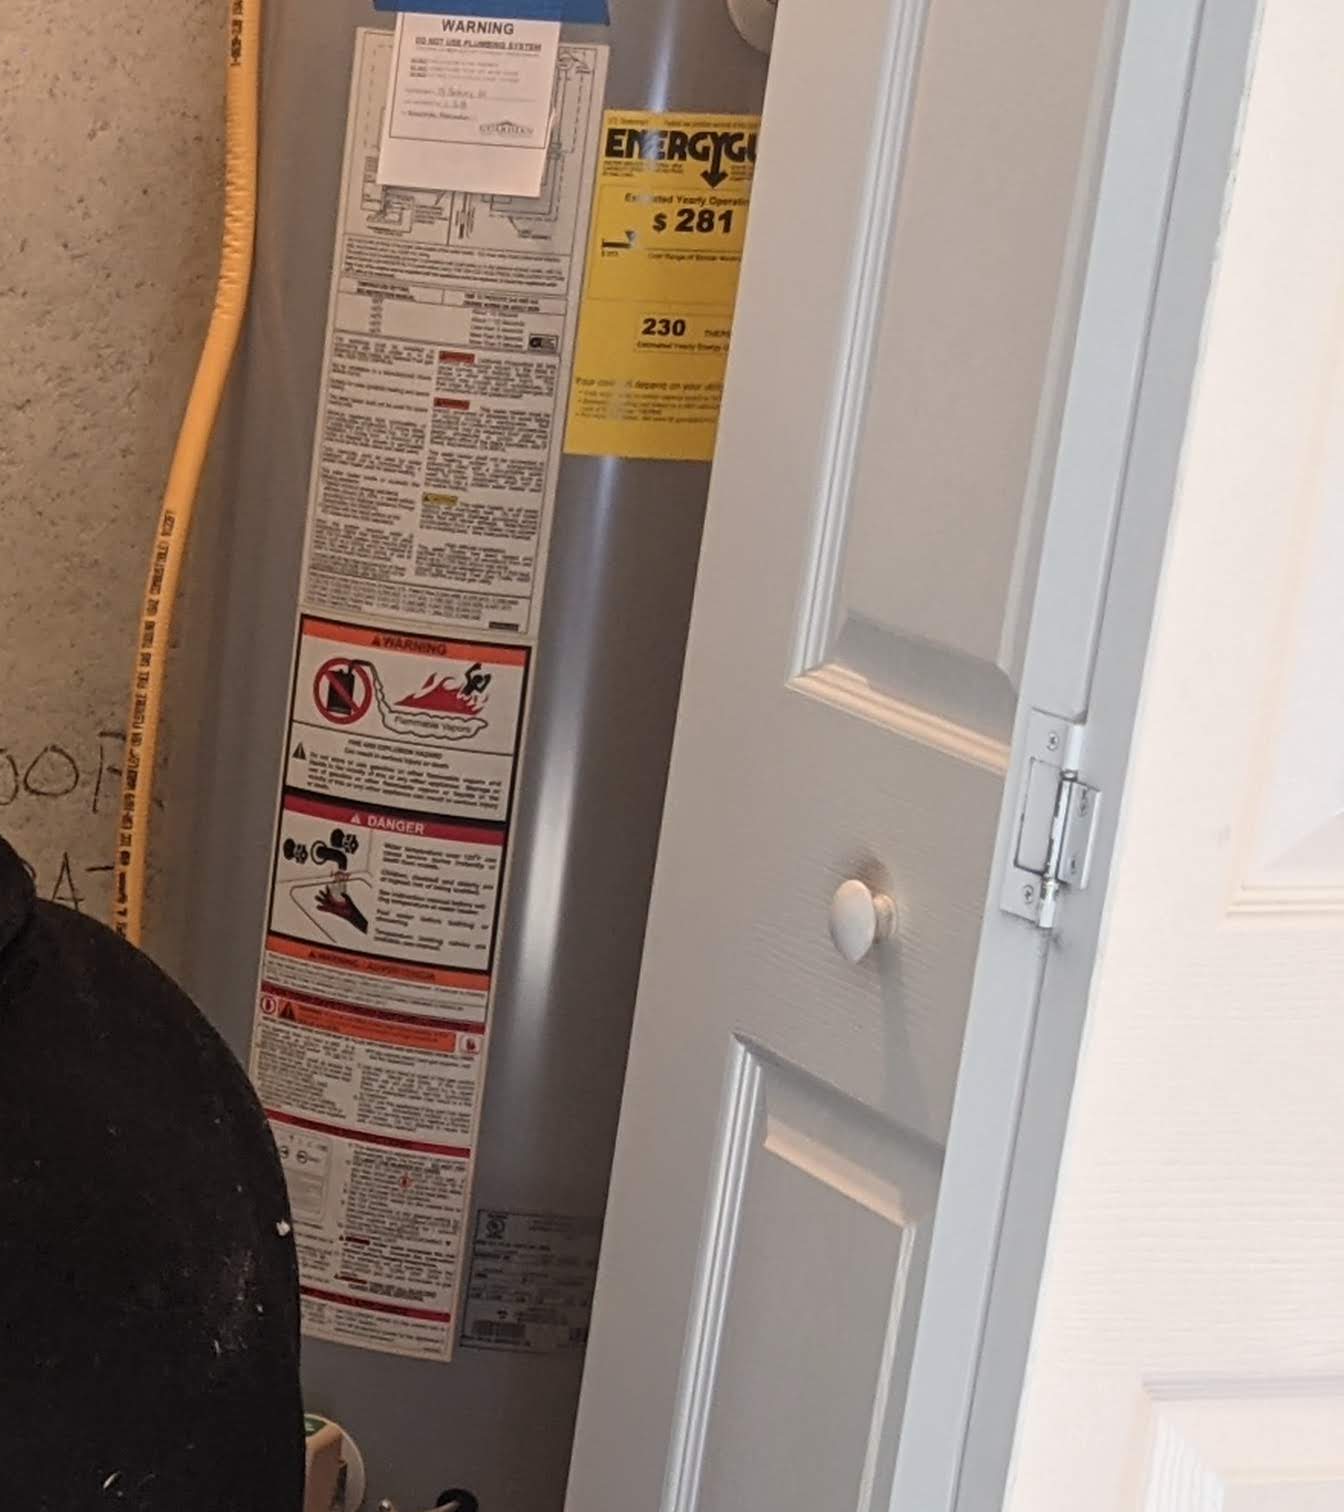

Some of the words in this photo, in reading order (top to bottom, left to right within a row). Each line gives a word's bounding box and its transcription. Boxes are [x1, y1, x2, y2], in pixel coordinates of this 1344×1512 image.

[442, 19, 514, 34] WARNING
[508, 42, 542, 51] SYSTEM
[652, 212, 667, 232] $
[674, 208, 733, 233] 281
[642, 318, 686, 336] 230
[384, 636, 447, 656] WARNING
[394, 716, 438, 729] Flammable
[442, 721, 472, 733] Vapors
[368, 815, 424, 834] DANGER
